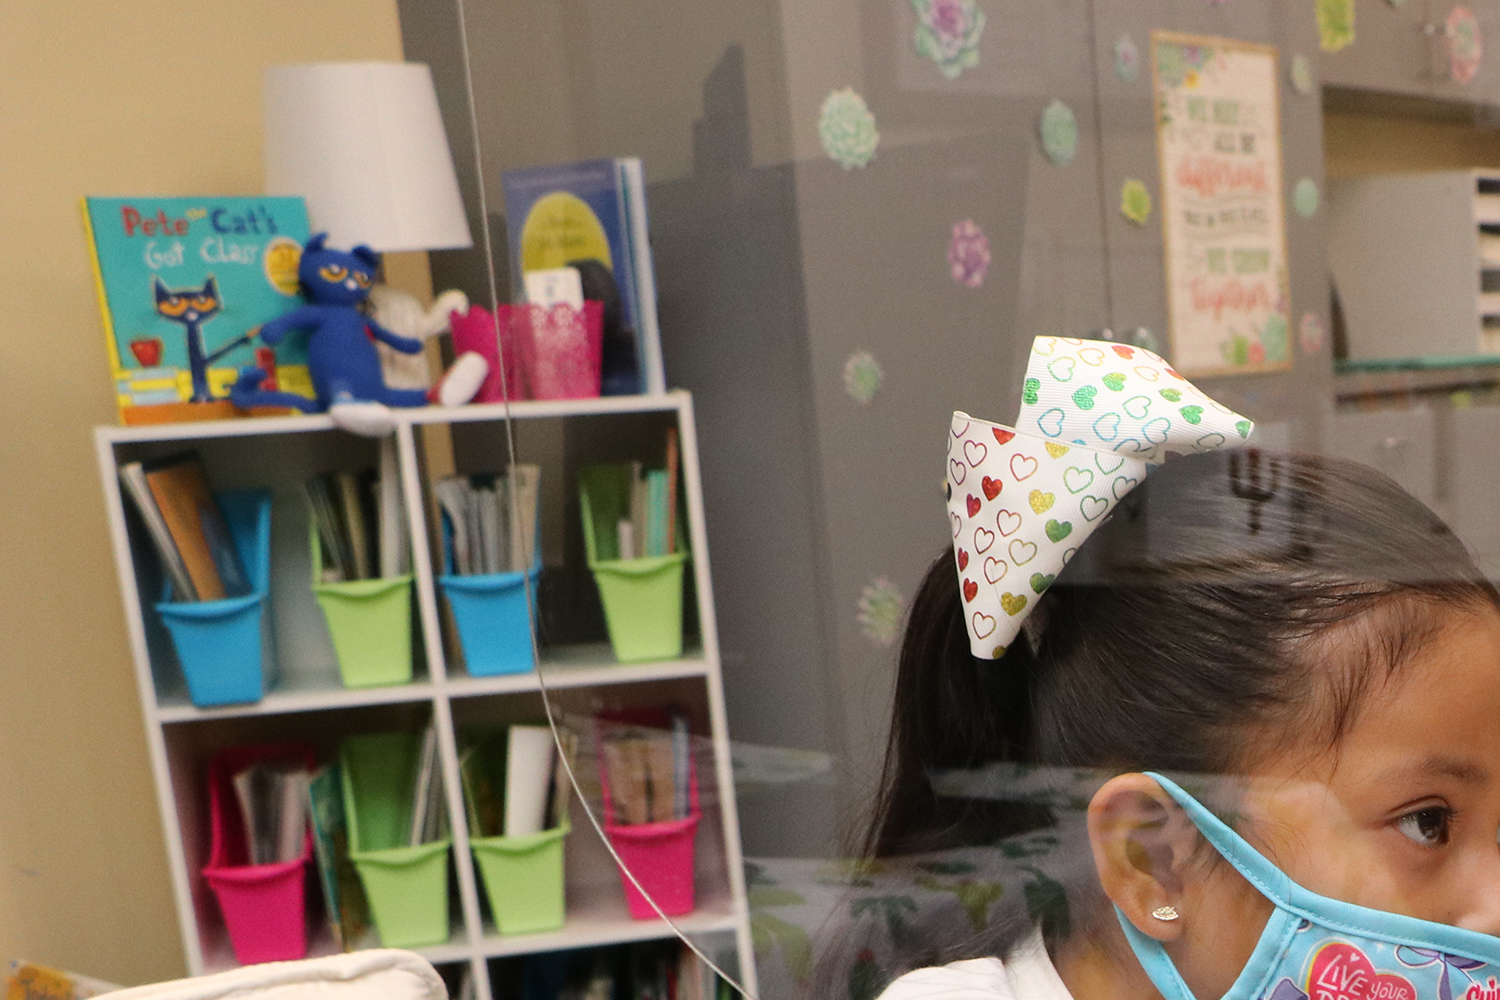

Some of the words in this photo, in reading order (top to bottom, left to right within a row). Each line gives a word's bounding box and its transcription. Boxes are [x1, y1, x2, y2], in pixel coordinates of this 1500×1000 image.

[120, 205, 189, 237] Pete
[211, 204, 279, 235] Cat's
[144, 241, 185, 270] Got
[201, 236, 259, 264] Class
[1316, 954, 1369, 997] LIVE
